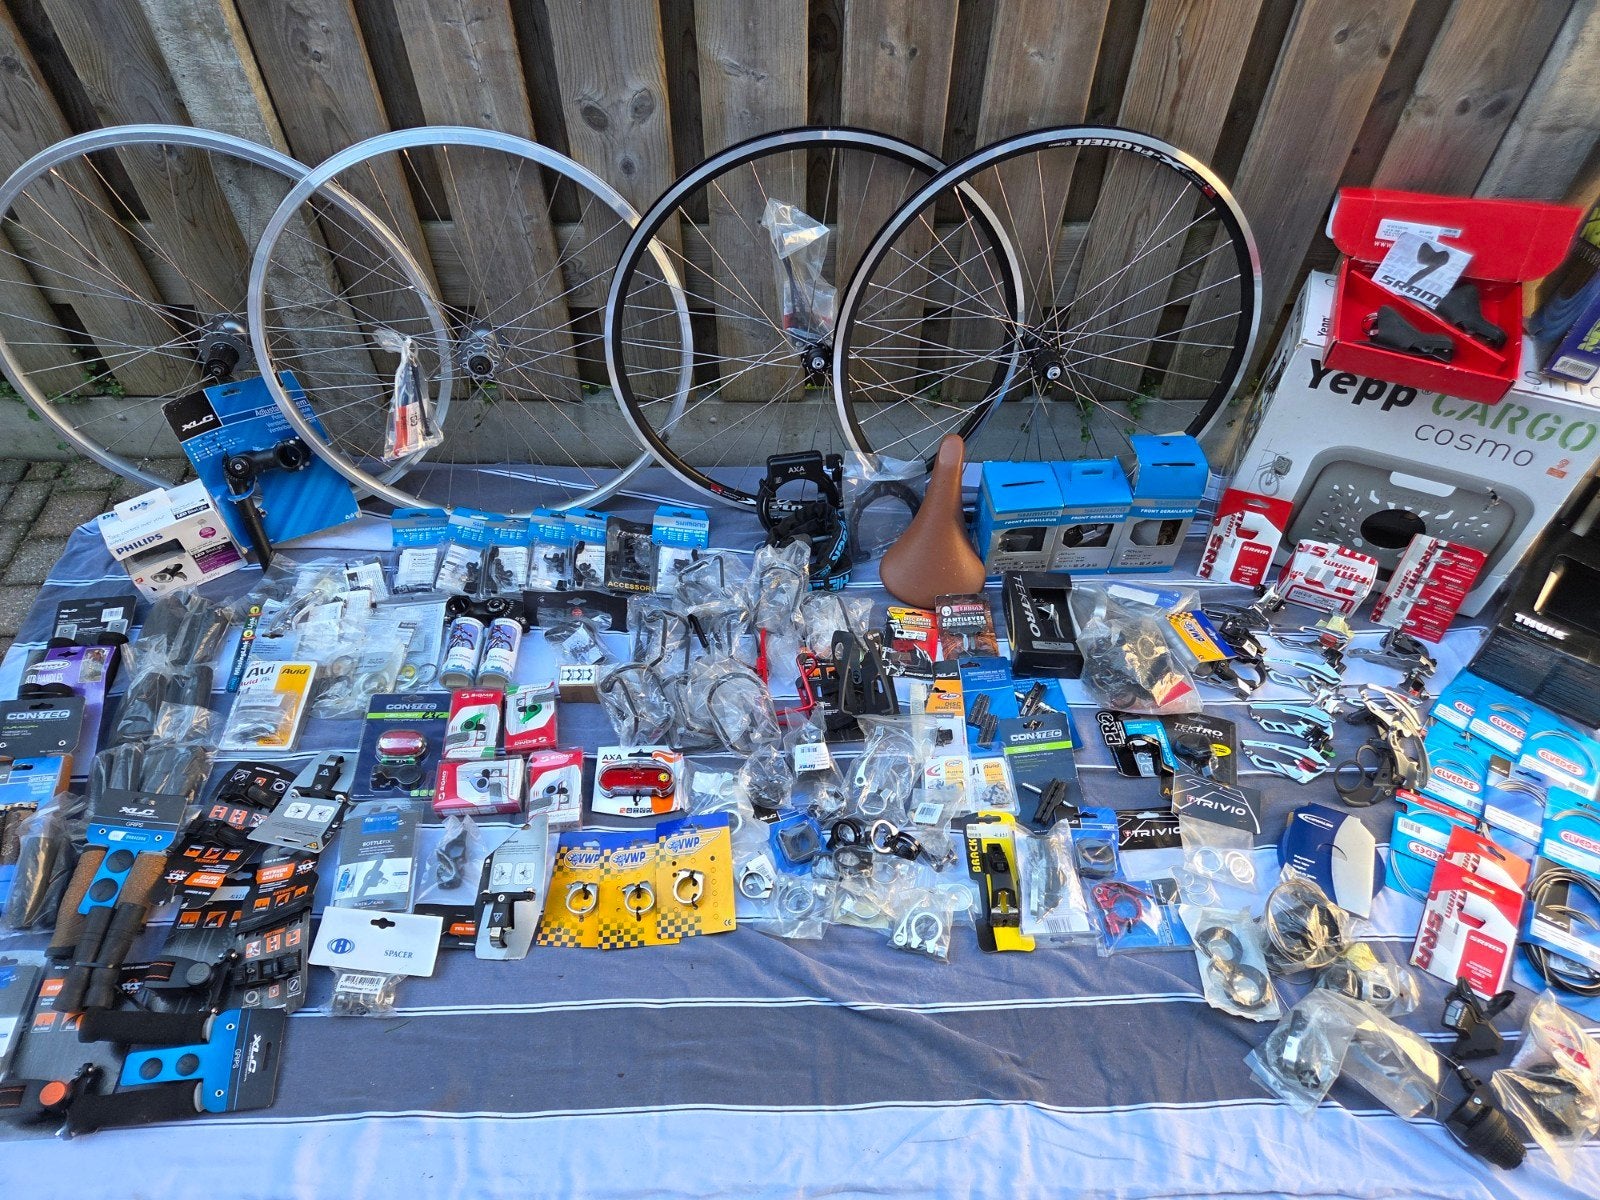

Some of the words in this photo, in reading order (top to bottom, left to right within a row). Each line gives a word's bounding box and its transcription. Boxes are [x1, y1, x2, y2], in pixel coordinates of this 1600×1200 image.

[1076, 138, 1192, 171] X-PLORER
[1379, 275, 1442, 304] SRAM
[1308, 359, 1418, 411] Yepp
[182, 414, 214, 432] XLC
[1431, 393, 1598, 452] CARGO
[1414, 424, 1534, 467] cosmo
[788, 466, 805, 474] AXA
[116, 533, 163, 555] PHILIPS
[608, 580, 656, 593] ACCESSOR
[1013, 574, 1041, 638] TEKTRO
[1515, 612, 1571, 641] THULE
[1174, 722, 1224, 737] TEKTRO
[1541, 751, 1578, 774] ELVEDES
[1437, 769, 1474, 790] ELVEDES
[118, 806, 156, 816] XLC
[1195, 797, 1247, 816] TRIVIO
[362, 839, 391, 847] BOTTLEFIX
[678, 836, 700, 850] VWP
[624, 851, 646, 863] VWP
[383, 949, 414, 959] SPACER
[232, 1048, 242, 1069] GRIPS
[247, 1033, 262, 1074] XLC
